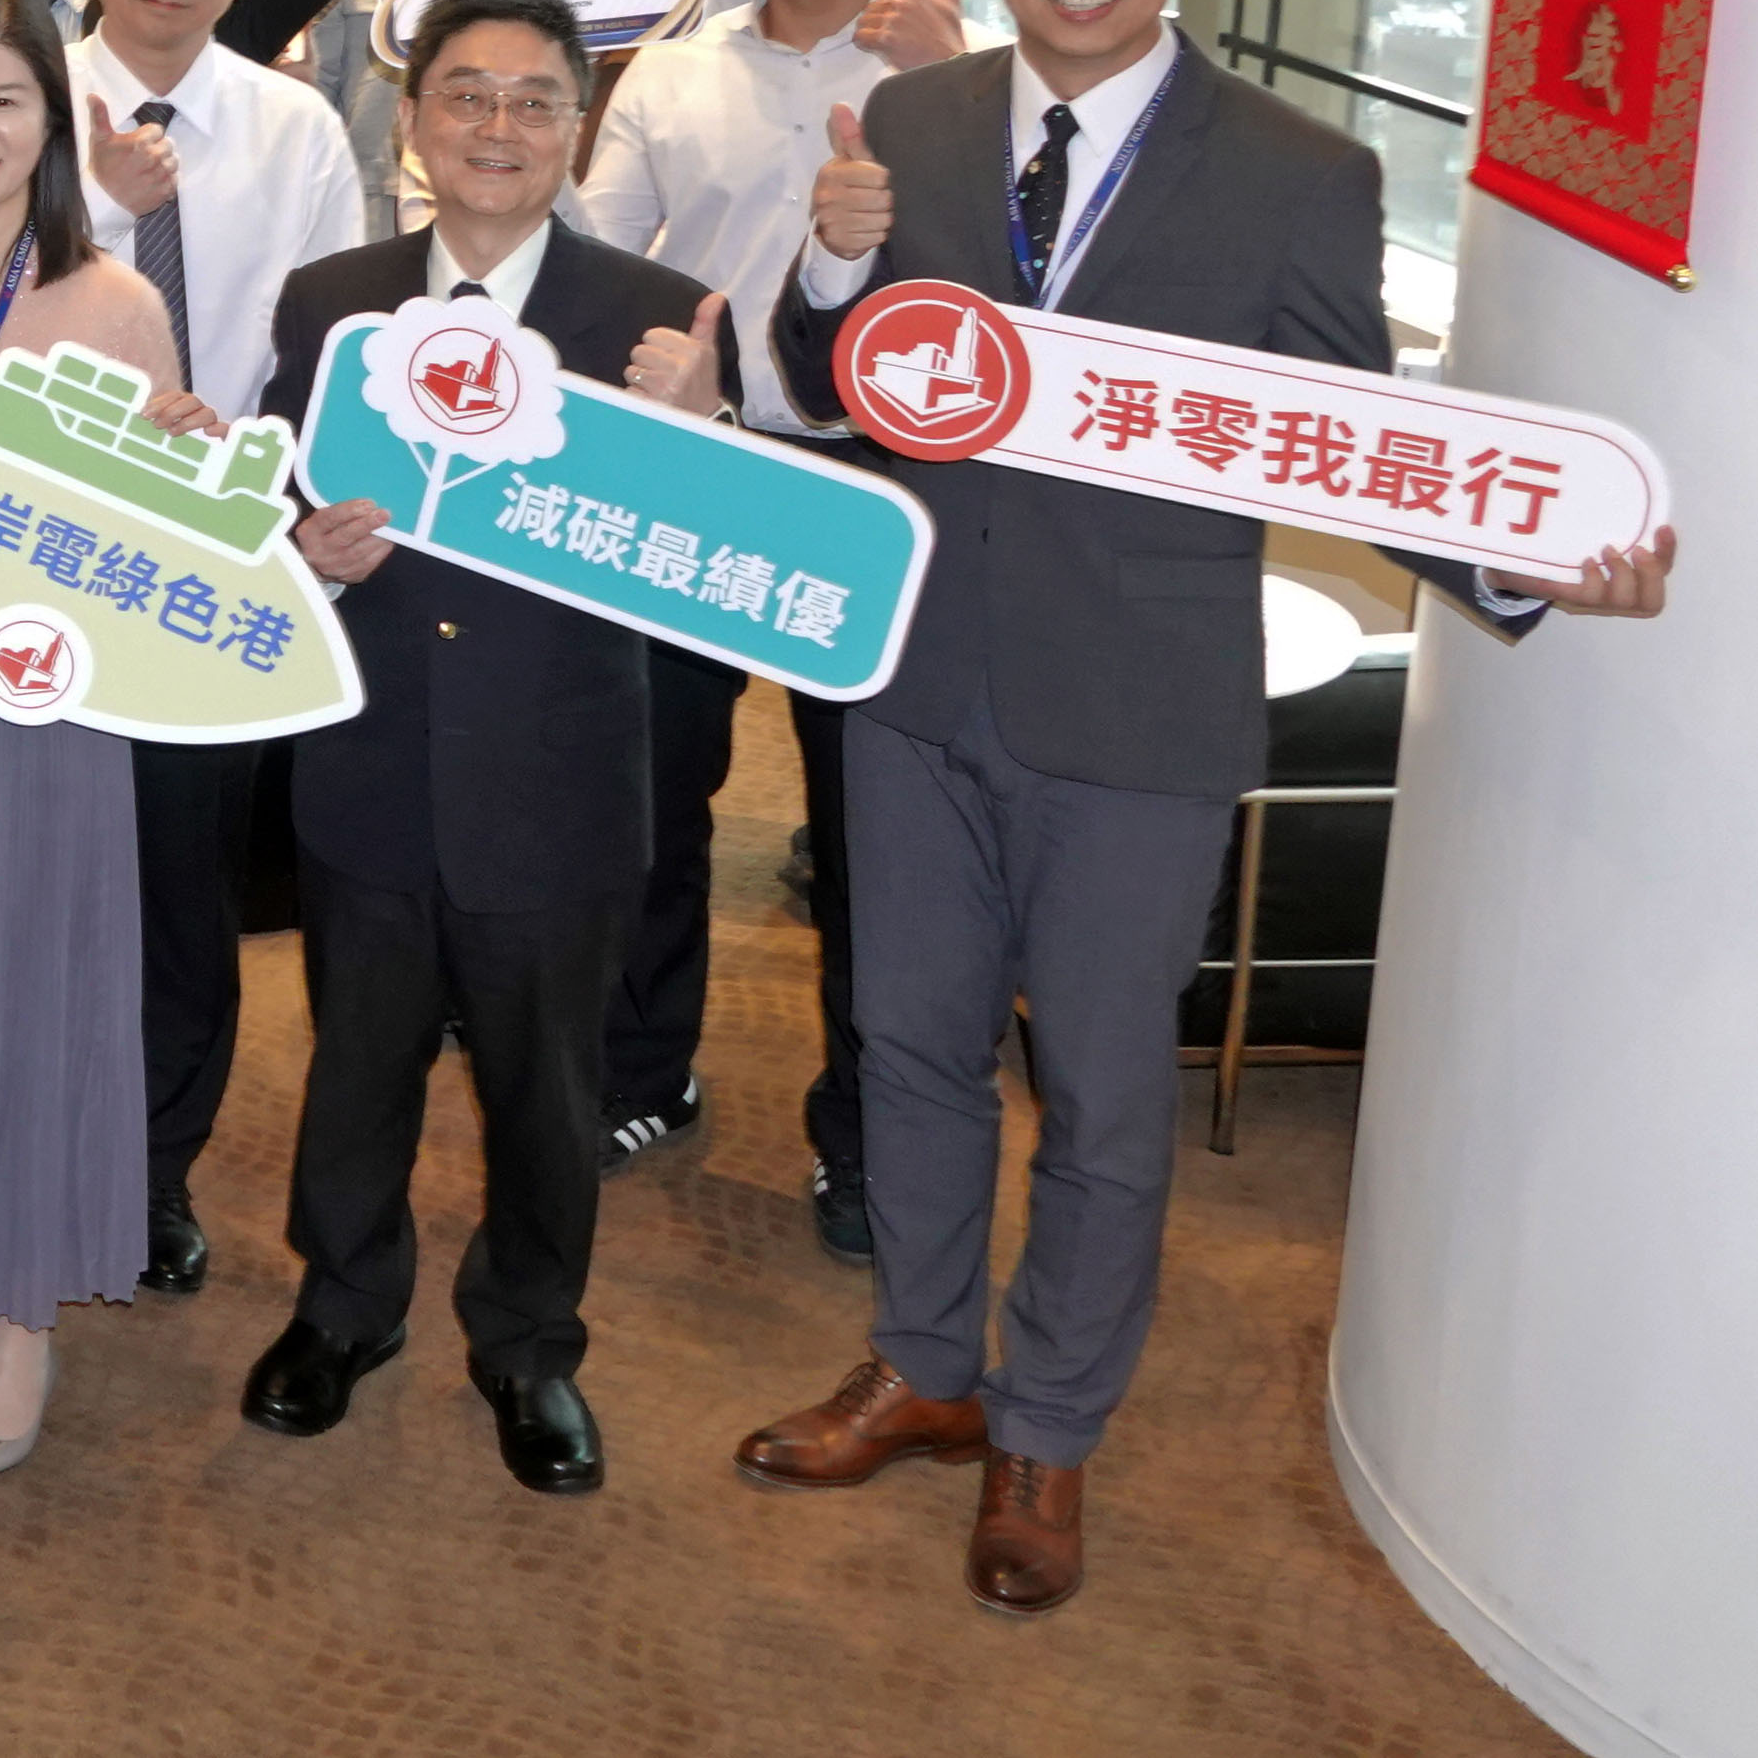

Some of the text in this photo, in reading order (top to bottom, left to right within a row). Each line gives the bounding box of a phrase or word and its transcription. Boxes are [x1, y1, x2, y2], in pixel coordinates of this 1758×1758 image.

[1070, 370, 1562, 537] 淨零我最行
[494, 471, 853, 650] 減碳最績優
